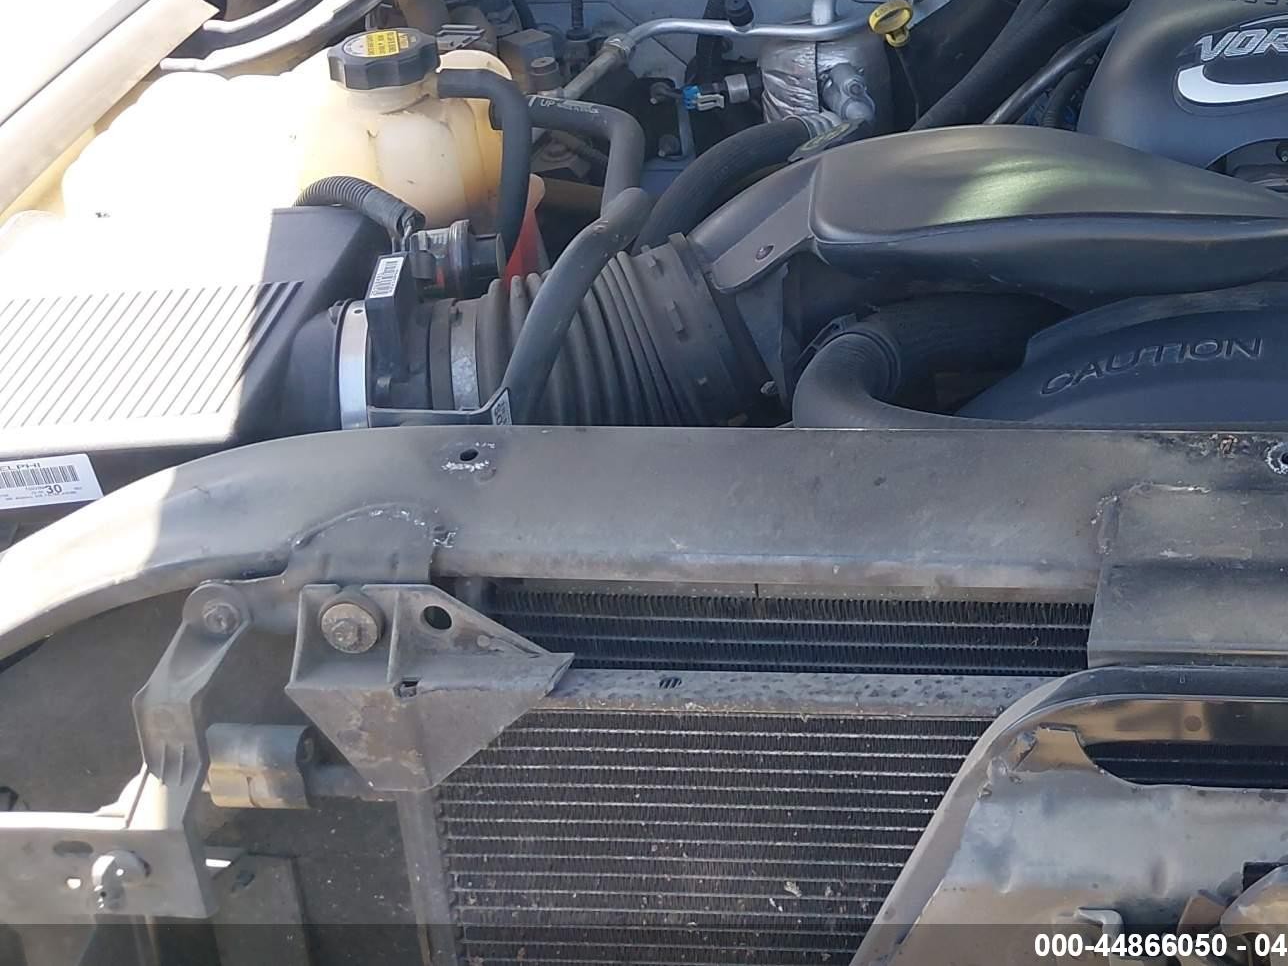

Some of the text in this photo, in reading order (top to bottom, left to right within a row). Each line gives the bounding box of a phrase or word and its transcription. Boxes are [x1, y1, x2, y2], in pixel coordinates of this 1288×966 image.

[1039, 337, 1263, 396] CAUTION
[0, 462, 41, 471] ELPHI
[46, 484, 62, 494] 30
